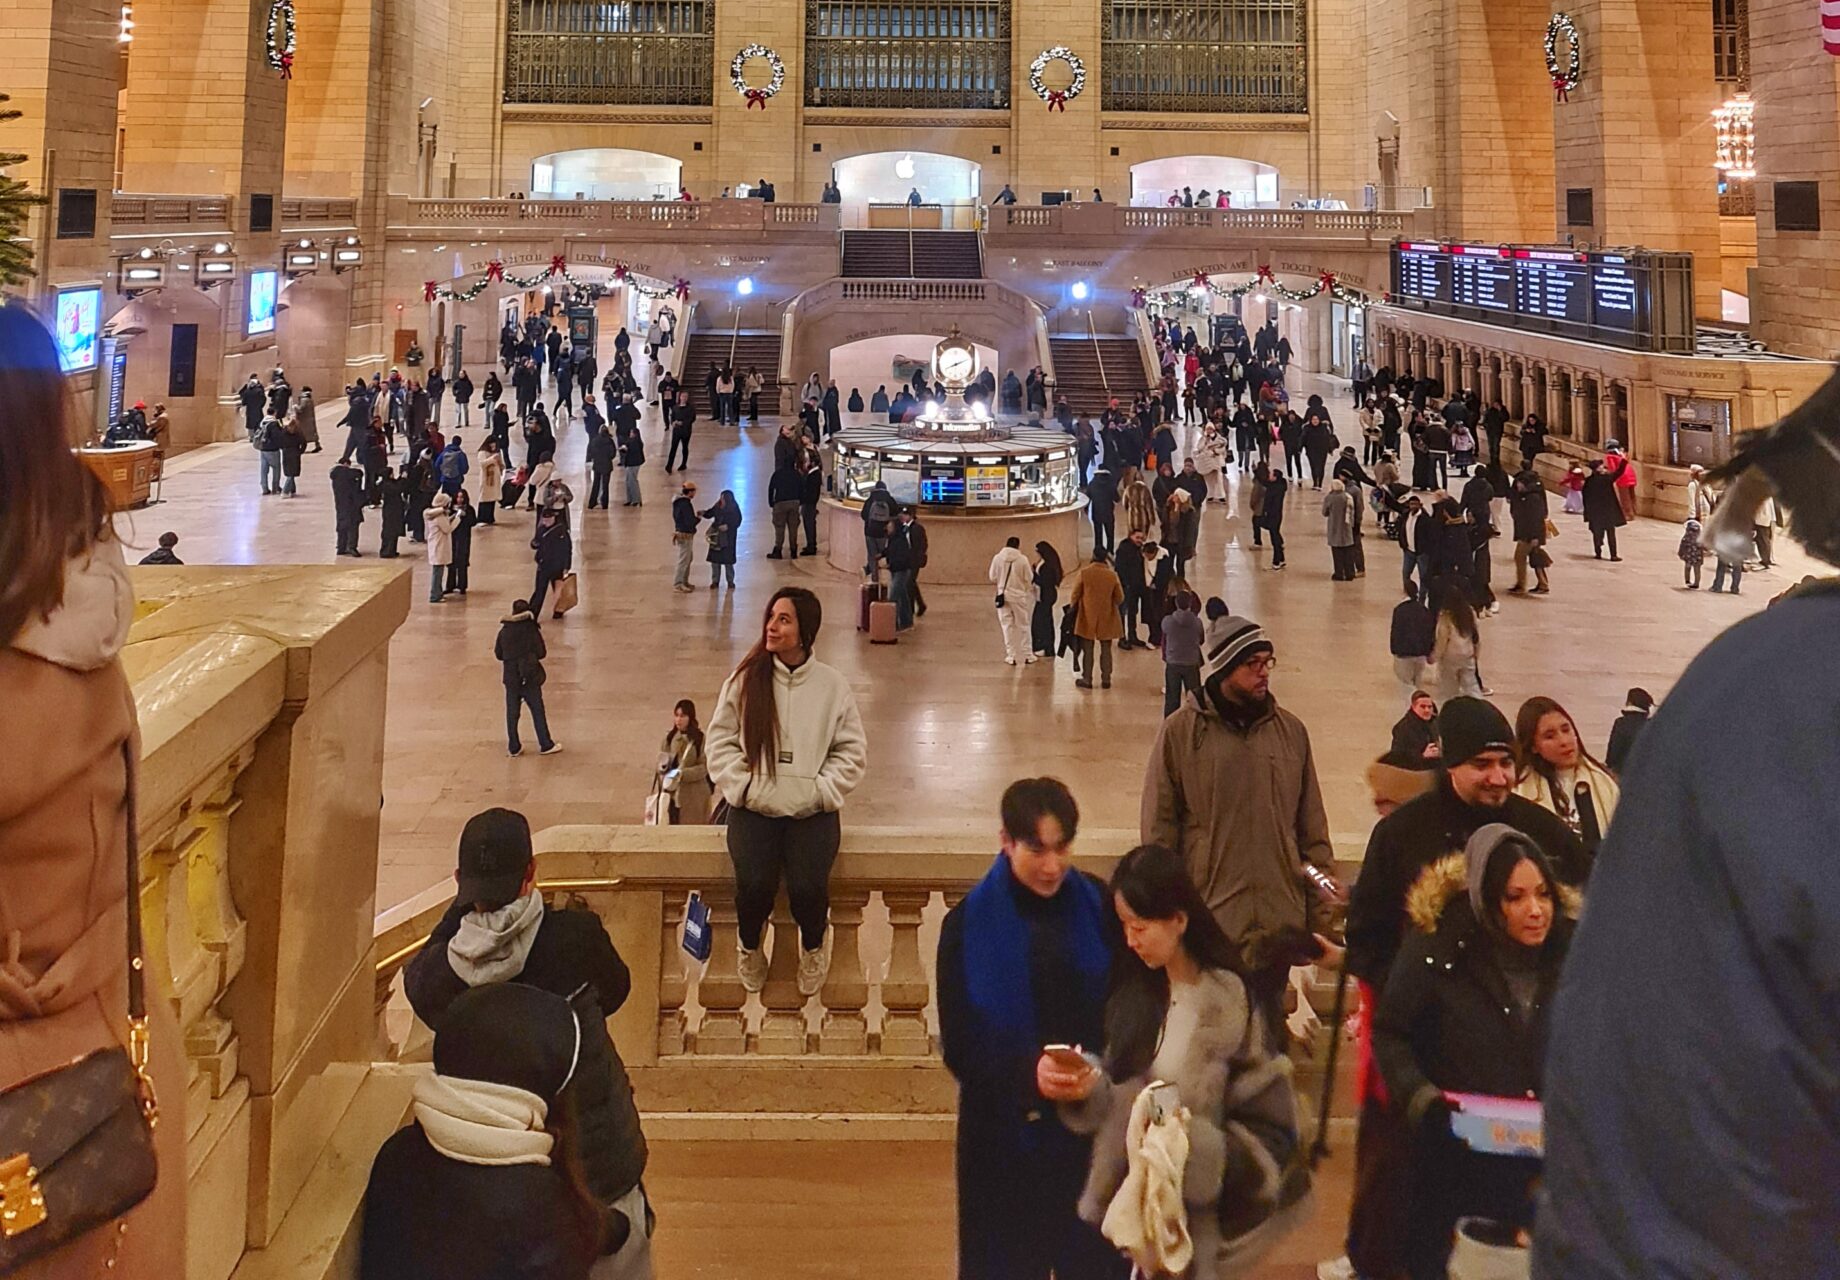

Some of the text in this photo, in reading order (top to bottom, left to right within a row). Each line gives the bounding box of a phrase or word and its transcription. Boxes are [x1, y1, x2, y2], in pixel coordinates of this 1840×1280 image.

[519, 254, 533, 262] TO
[633, 262, 652, 272] AVE
[1230, 261, 1249, 270] AVE
[1281, 262, 1312, 273] TICKET
